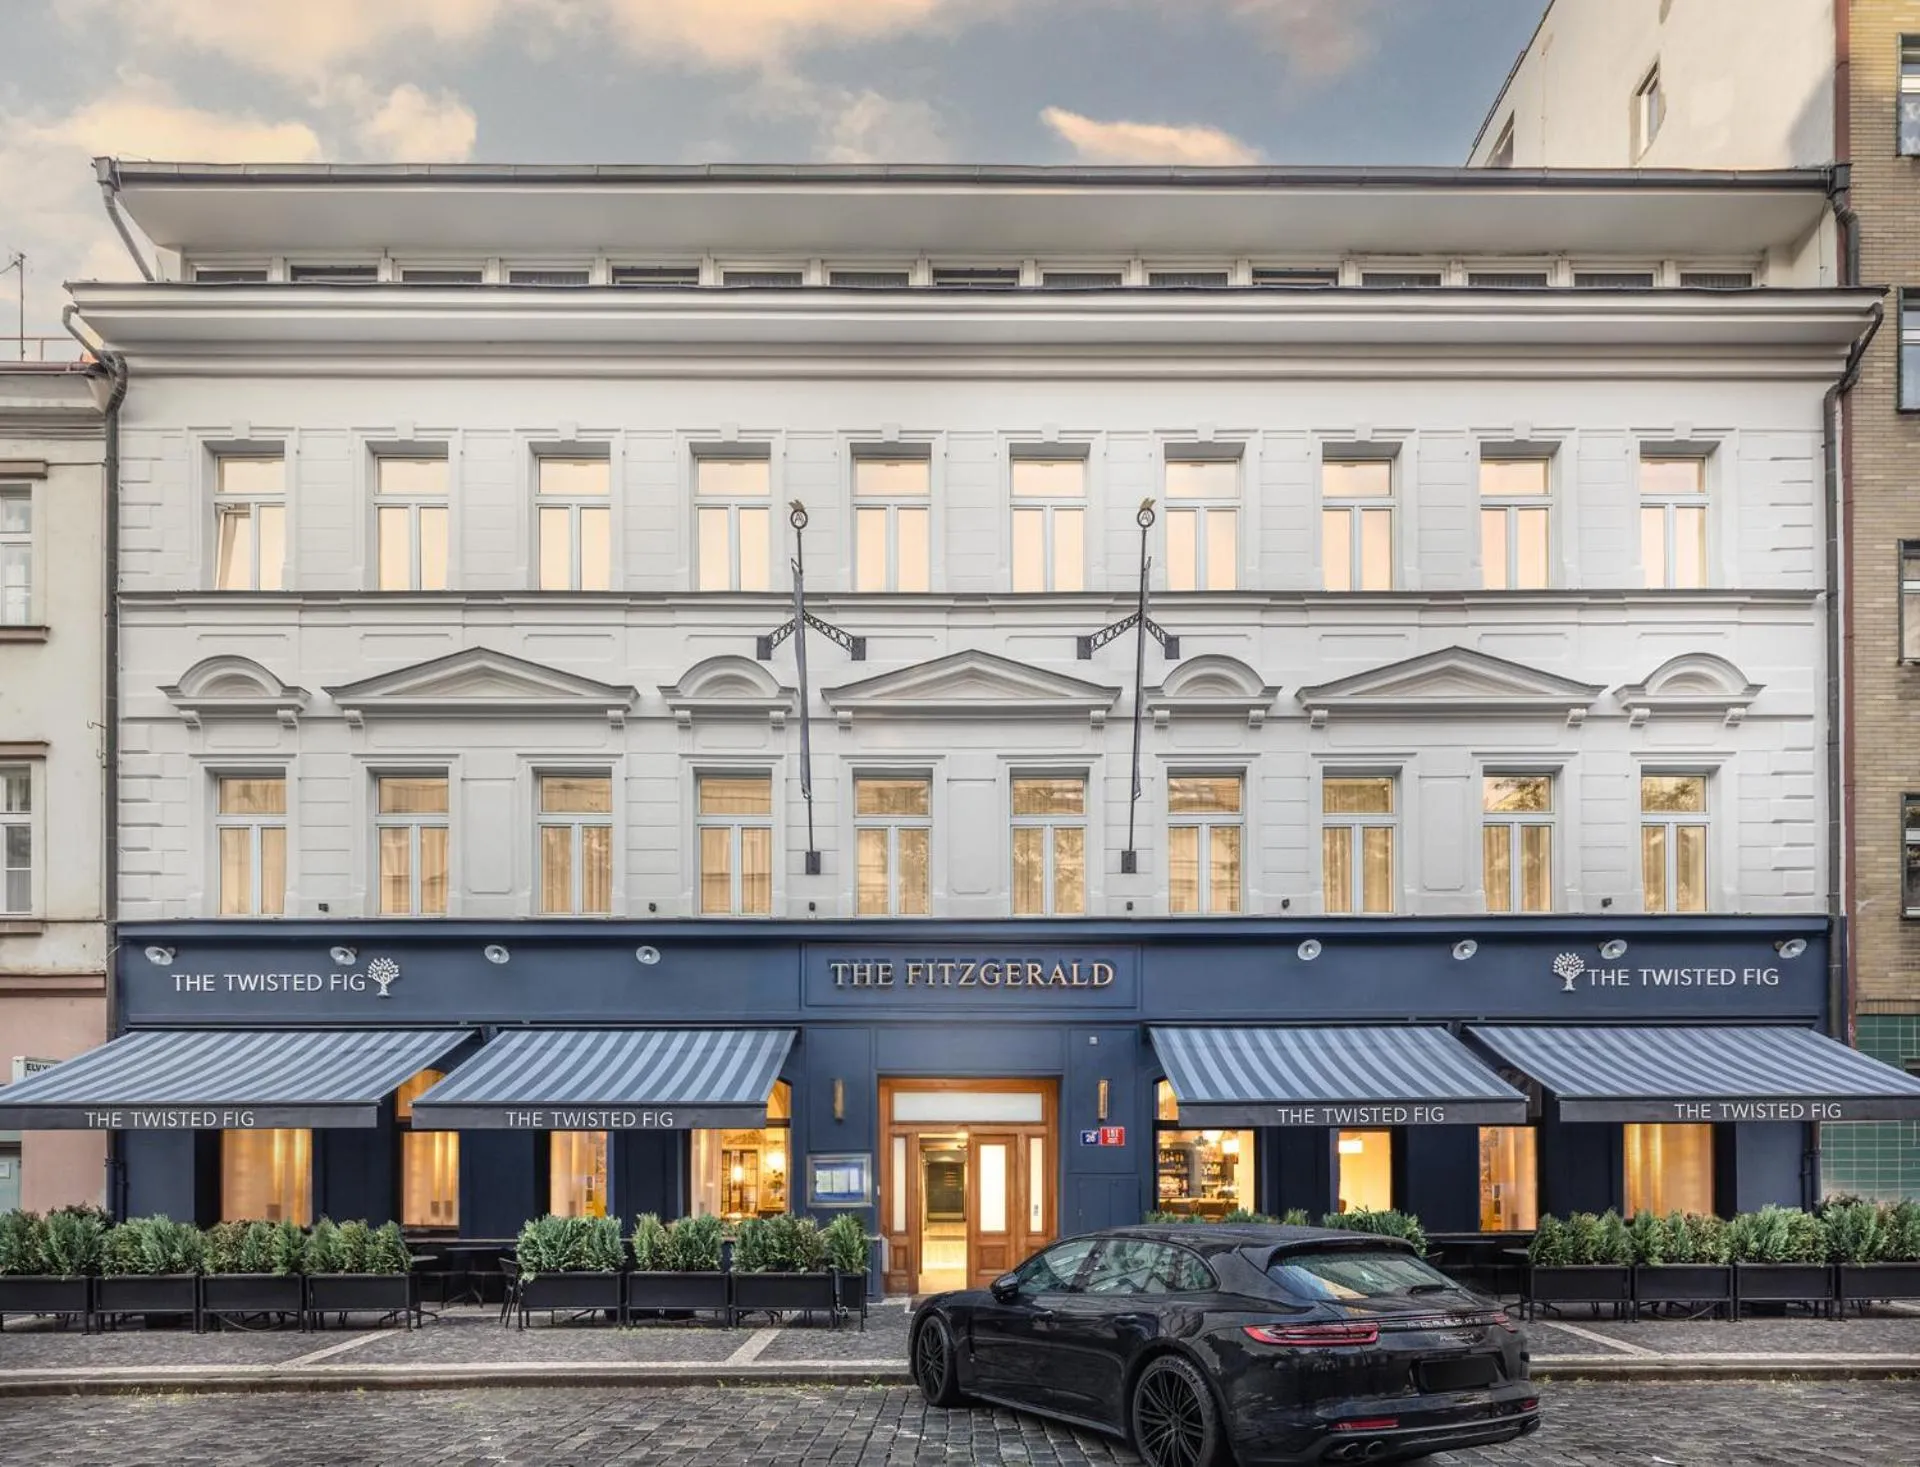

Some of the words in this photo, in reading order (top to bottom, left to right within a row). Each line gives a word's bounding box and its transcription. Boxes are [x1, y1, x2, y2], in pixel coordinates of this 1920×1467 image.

[171, 973, 215, 992] THE
[223, 973, 323, 992] TWISTED
[330, 973, 366, 992] FIG
[830, 962, 893, 986] THE
[907, 962, 1115, 987] FITZGERALD
[1587, 968, 1630, 986] THE
[1638, 968, 1737, 986] TWISTED
[1744, 968, 1780, 986] FIG
[85, 1111, 122, 1128] THE
[130, 1111, 216, 1128] TWISTED
[223, 1111, 255, 1128] FIG
[505, 1111, 543, 1128] THE
[551, 1111, 636, 1128] TWISTED
[643, 1111, 674, 1128] FIG
[1277, 1108, 1315, 1124] THE
[1322, 1107, 1408, 1123] TWISTED
[1415, 1106, 1446, 1123] FIG
[1673, 1103, 1711, 1119] THE
[1719, 1103, 1805, 1119] TWISTED
[1812, 1103, 1843, 1119] FIG
